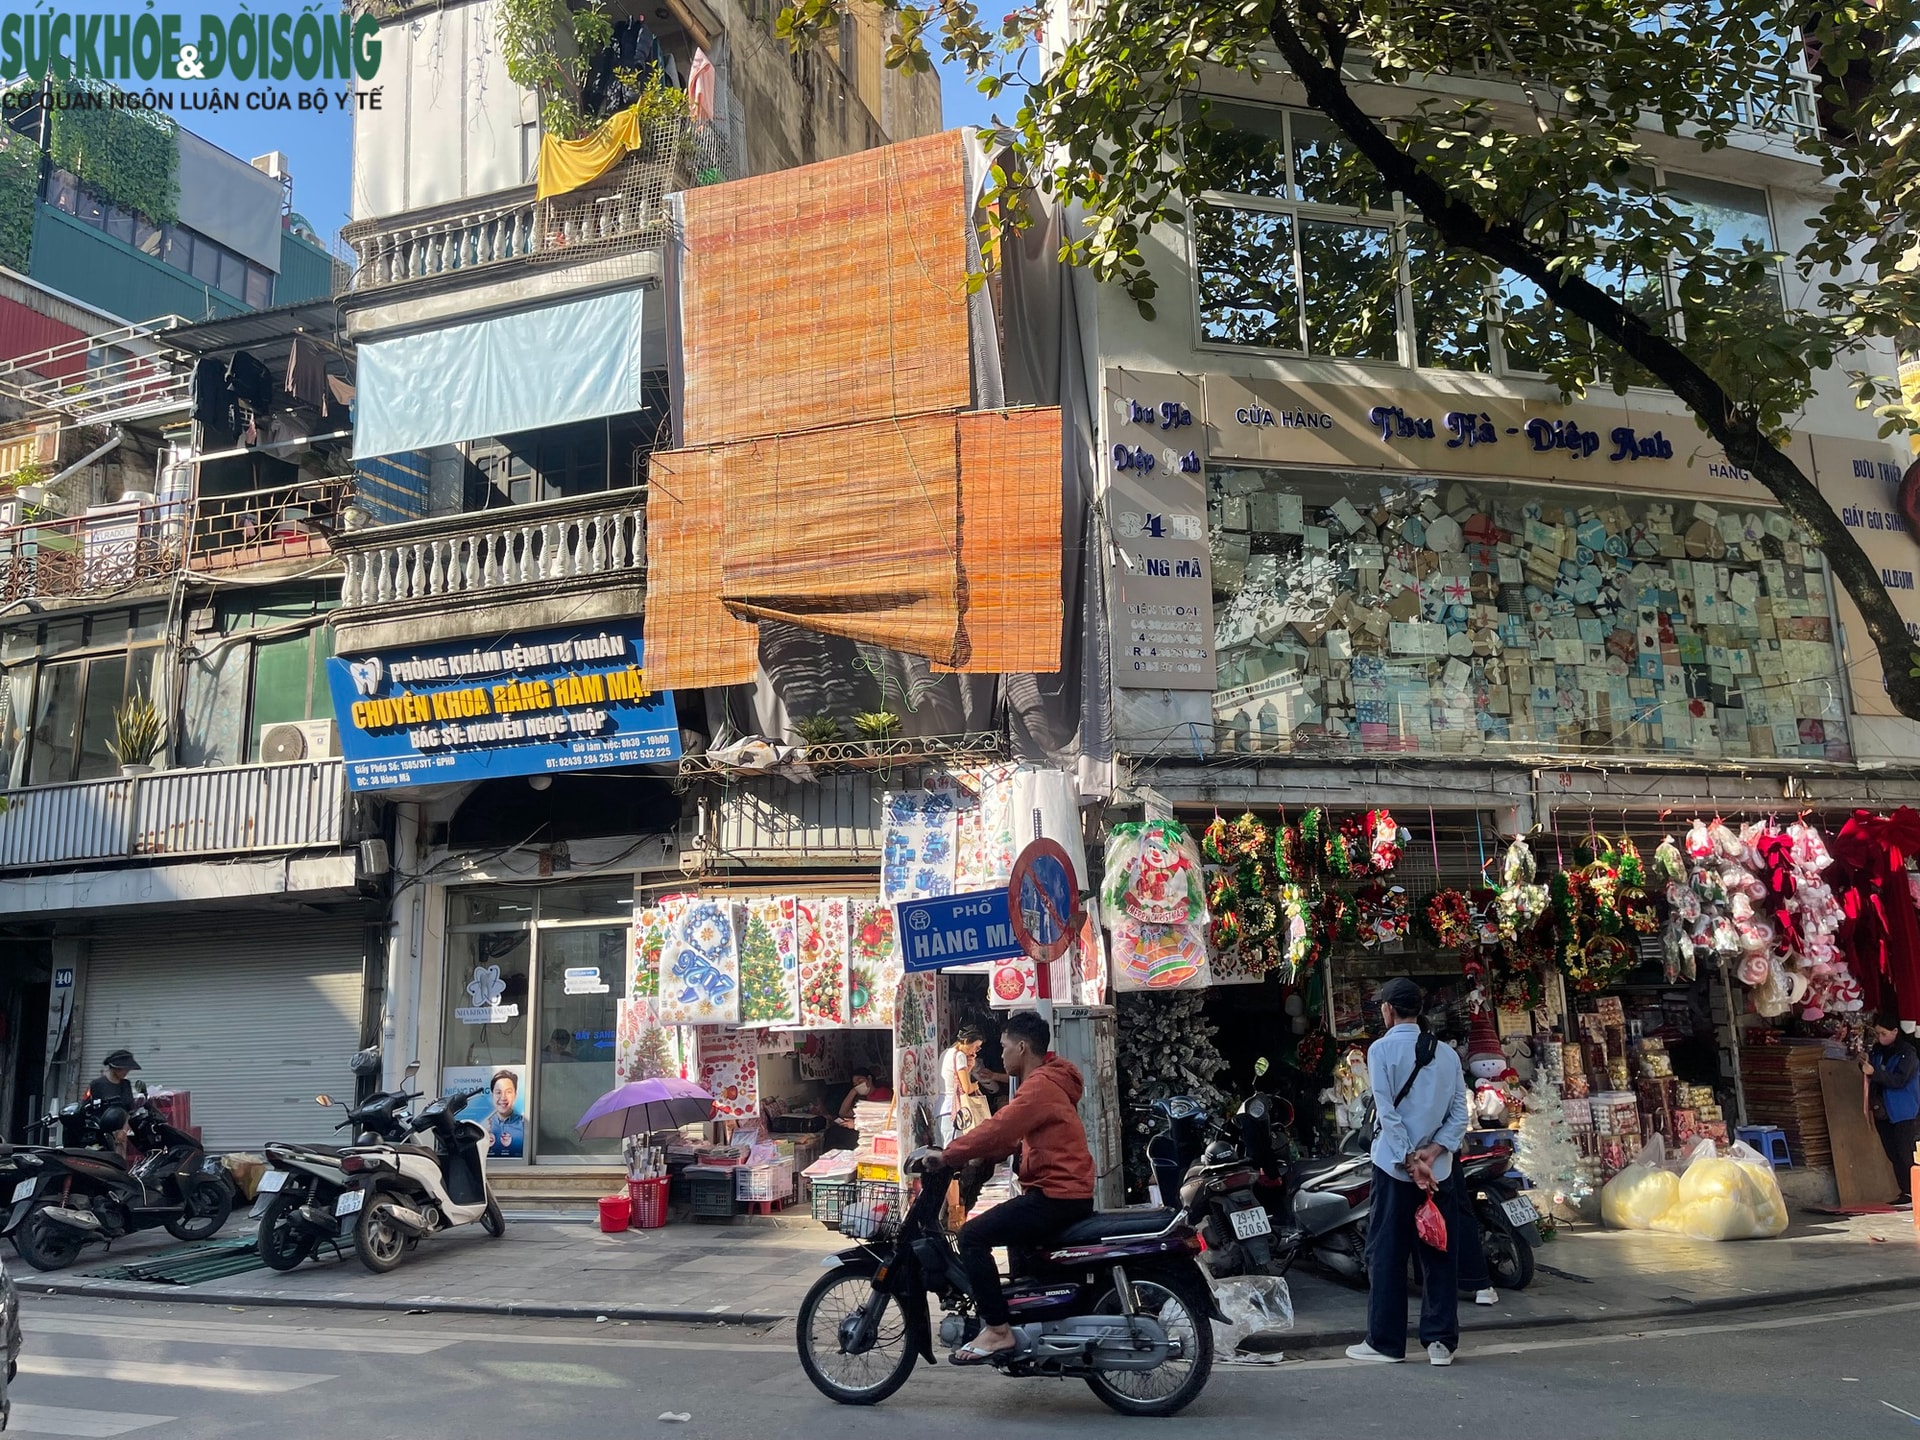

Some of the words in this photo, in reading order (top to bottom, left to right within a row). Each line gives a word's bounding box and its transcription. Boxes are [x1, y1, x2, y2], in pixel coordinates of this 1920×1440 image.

[1235, 402, 1277, 426] CỬA
[1280, 406, 1333, 429] HÀNG
[1369, 406, 1435, 443] Thu
[1444, 411, 1498, 449] Hà
[1524, 417, 1600, 461] Diệp
[1609, 427, 1674, 462] Anh
[1867, 507, 1884, 530] GÓI
[1175, 557, 1203, 579] MÃ
[1882, 568, 1914, 590] ALBUM
[390, 655, 449, 683] PHÒNG
[448, 648, 503, 676] KHÁM
[502, 642, 549, 672] BỆNH
[549, 640, 574, 664] TƯ
[574, 632, 627, 661] NHÂN
[351, 690, 432, 730] CHUYÊN
[431, 687, 491, 721] KHOA
[492, 678, 552, 714] RĂNG
[552, 671, 606, 707] HÀM
[410, 725, 441, 748] BÁC
[466, 713, 525, 743] NGUYỄN
[525, 715, 568, 740] NGỌC
[568, 707, 608, 735] THẬP
[599, 752, 614, 762] 253
[640, 748, 655, 758] 532
[656, 746, 672, 757] 225
[952, 897, 992, 919] PHỐ
[914, 927, 979, 959] HÀNG
[55, 971, 72, 985] 40
[1236, 1209, 1261, 1225] 29-F1
[1045, 1289, 1071, 1297] HONDA
